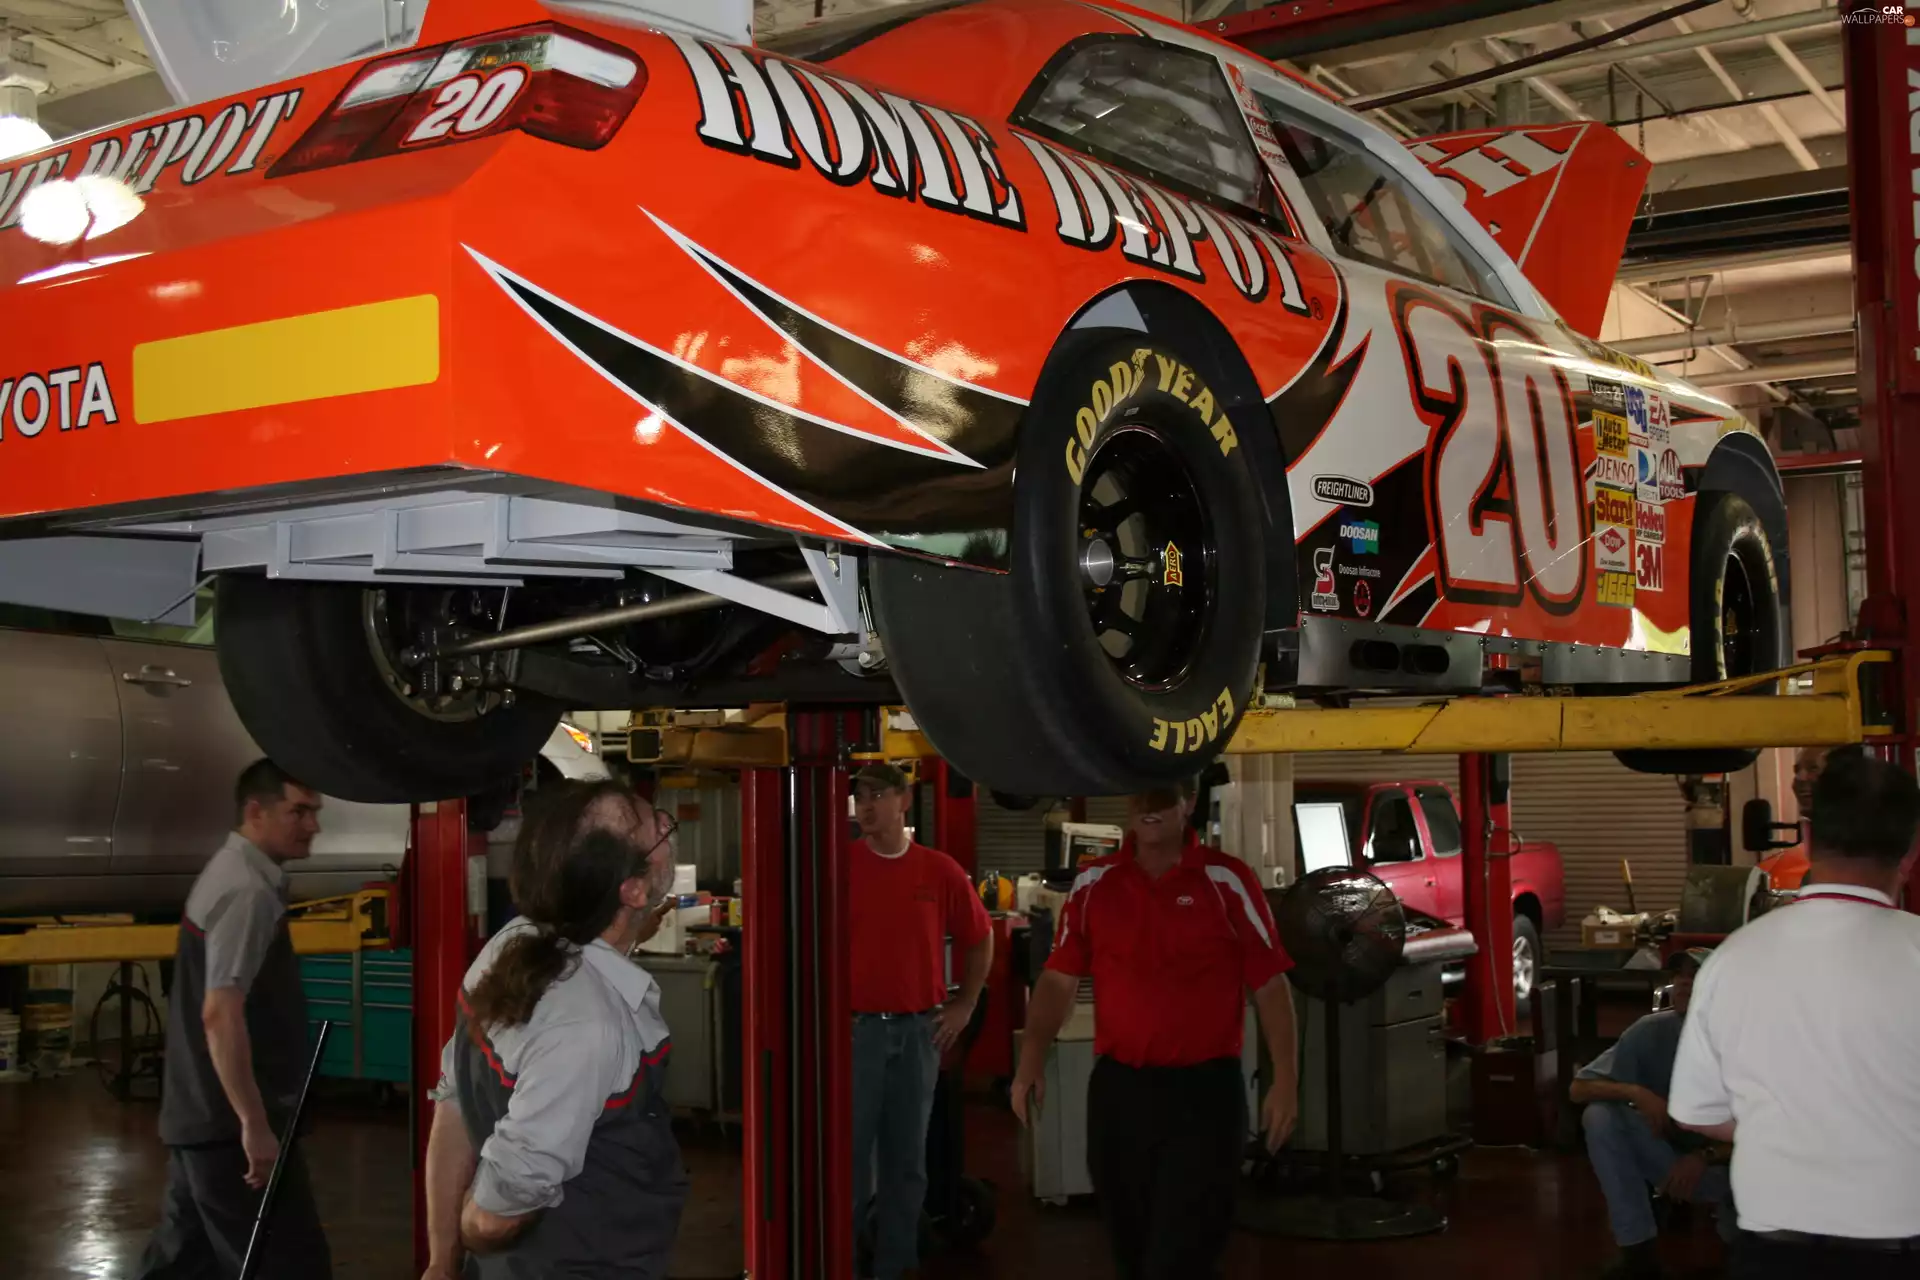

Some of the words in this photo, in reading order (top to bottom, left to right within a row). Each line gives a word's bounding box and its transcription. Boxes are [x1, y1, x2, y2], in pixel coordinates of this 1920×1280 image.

[404, 66, 526, 147] 20
[667, 32, 1027, 231] HOME
[1009, 128, 1310, 317] DEPOT
[1603, 417, 1622, 436] Auto
[1603, 432, 1626, 452] Meter
[1390, 285, 1586, 612] 20
[1596, 456, 1635, 485] DENSO
[1316, 480, 1368, 501] FREIGHTLINER
[1660, 485, 1686, 500] TOOLS
[1596, 489, 1634, 526] Stant
[1339, 524, 1379, 541] DOOSAN
[1637, 544, 1662, 589] 3M
[1149, 686, 1234, 754] EAGLE
